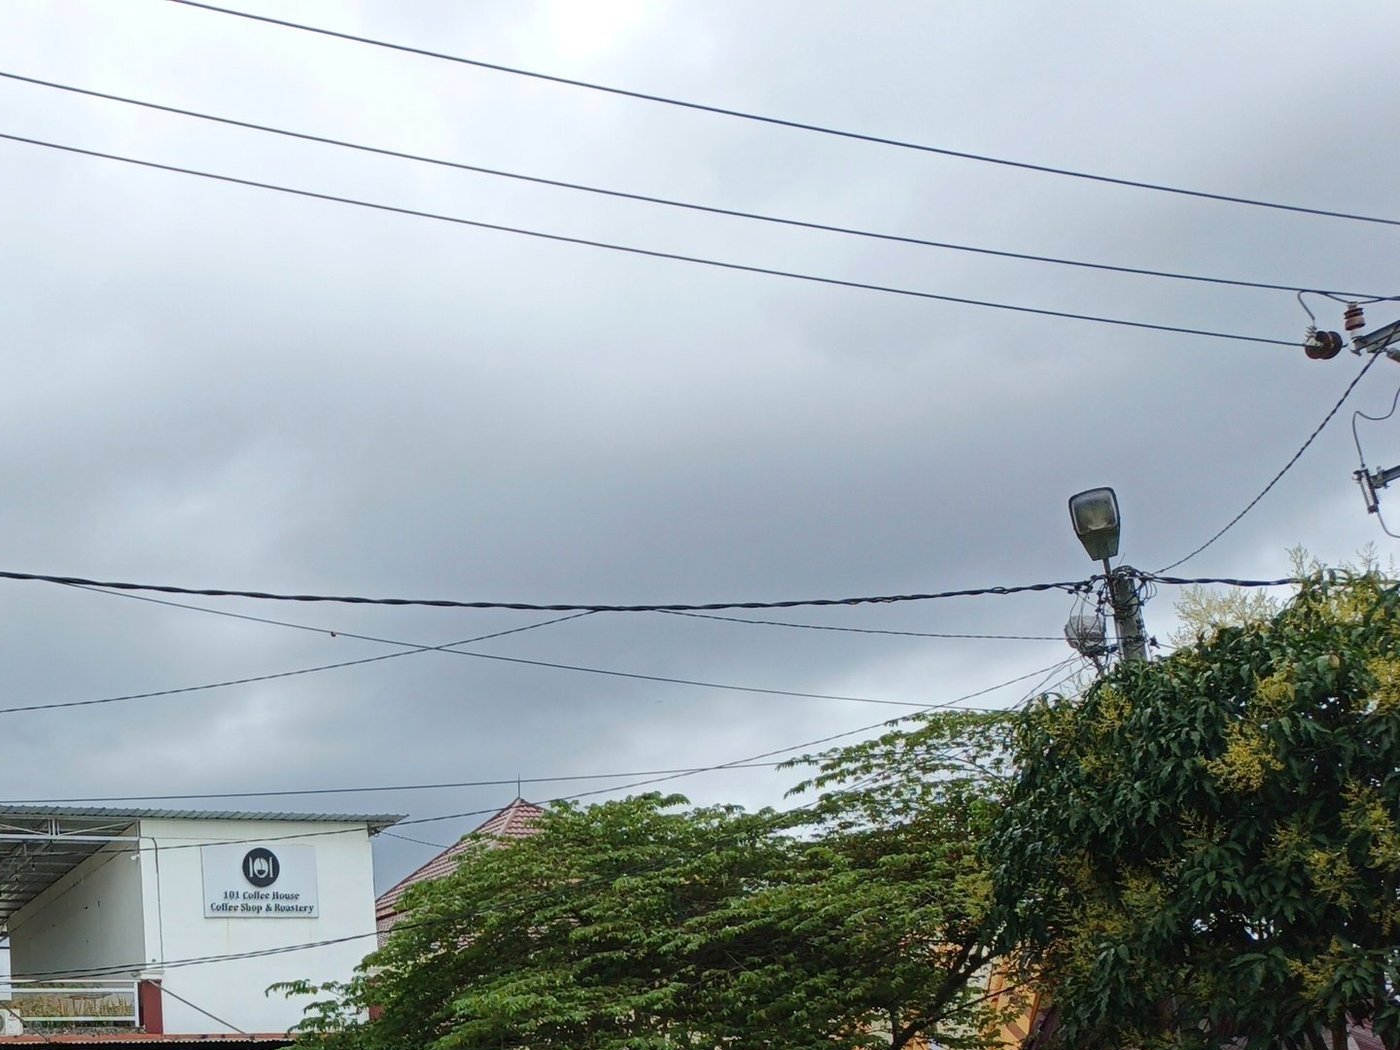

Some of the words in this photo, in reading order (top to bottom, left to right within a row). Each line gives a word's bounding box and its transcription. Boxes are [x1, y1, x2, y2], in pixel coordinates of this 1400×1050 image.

[223, 890, 240, 900] 101
[242, 891, 270, 900] Coffee
[272, 891, 300, 901] House
[210, 902, 239, 912] Coffee
[240, 903, 263, 914] Shop
[265, 903, 272, 912] &
[274, 903, 315, 914] Roastery
